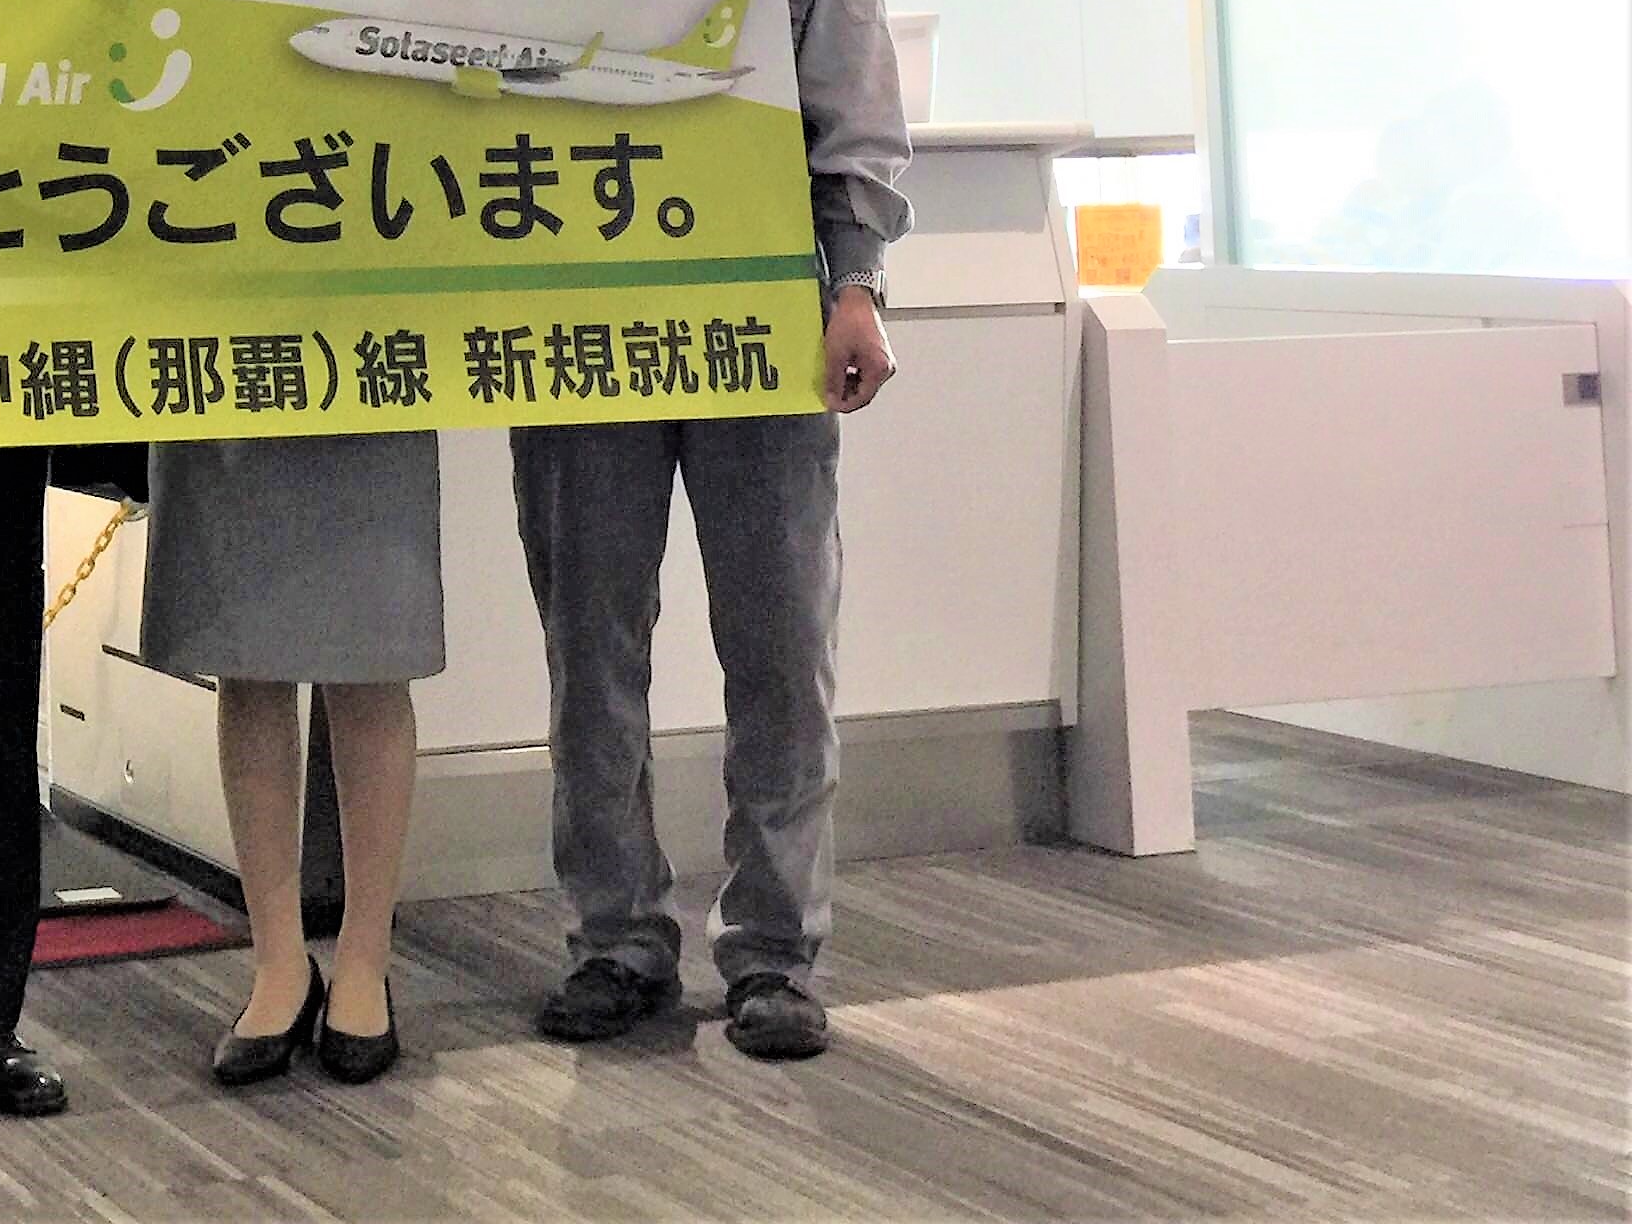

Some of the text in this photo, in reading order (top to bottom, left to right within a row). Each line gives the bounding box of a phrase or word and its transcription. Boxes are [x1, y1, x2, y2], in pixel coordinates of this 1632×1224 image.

[355, 24, 507, 68] Solaseed
[16, 59, 91, 106] Air
[463, 314, 780, 405] 新規就航
